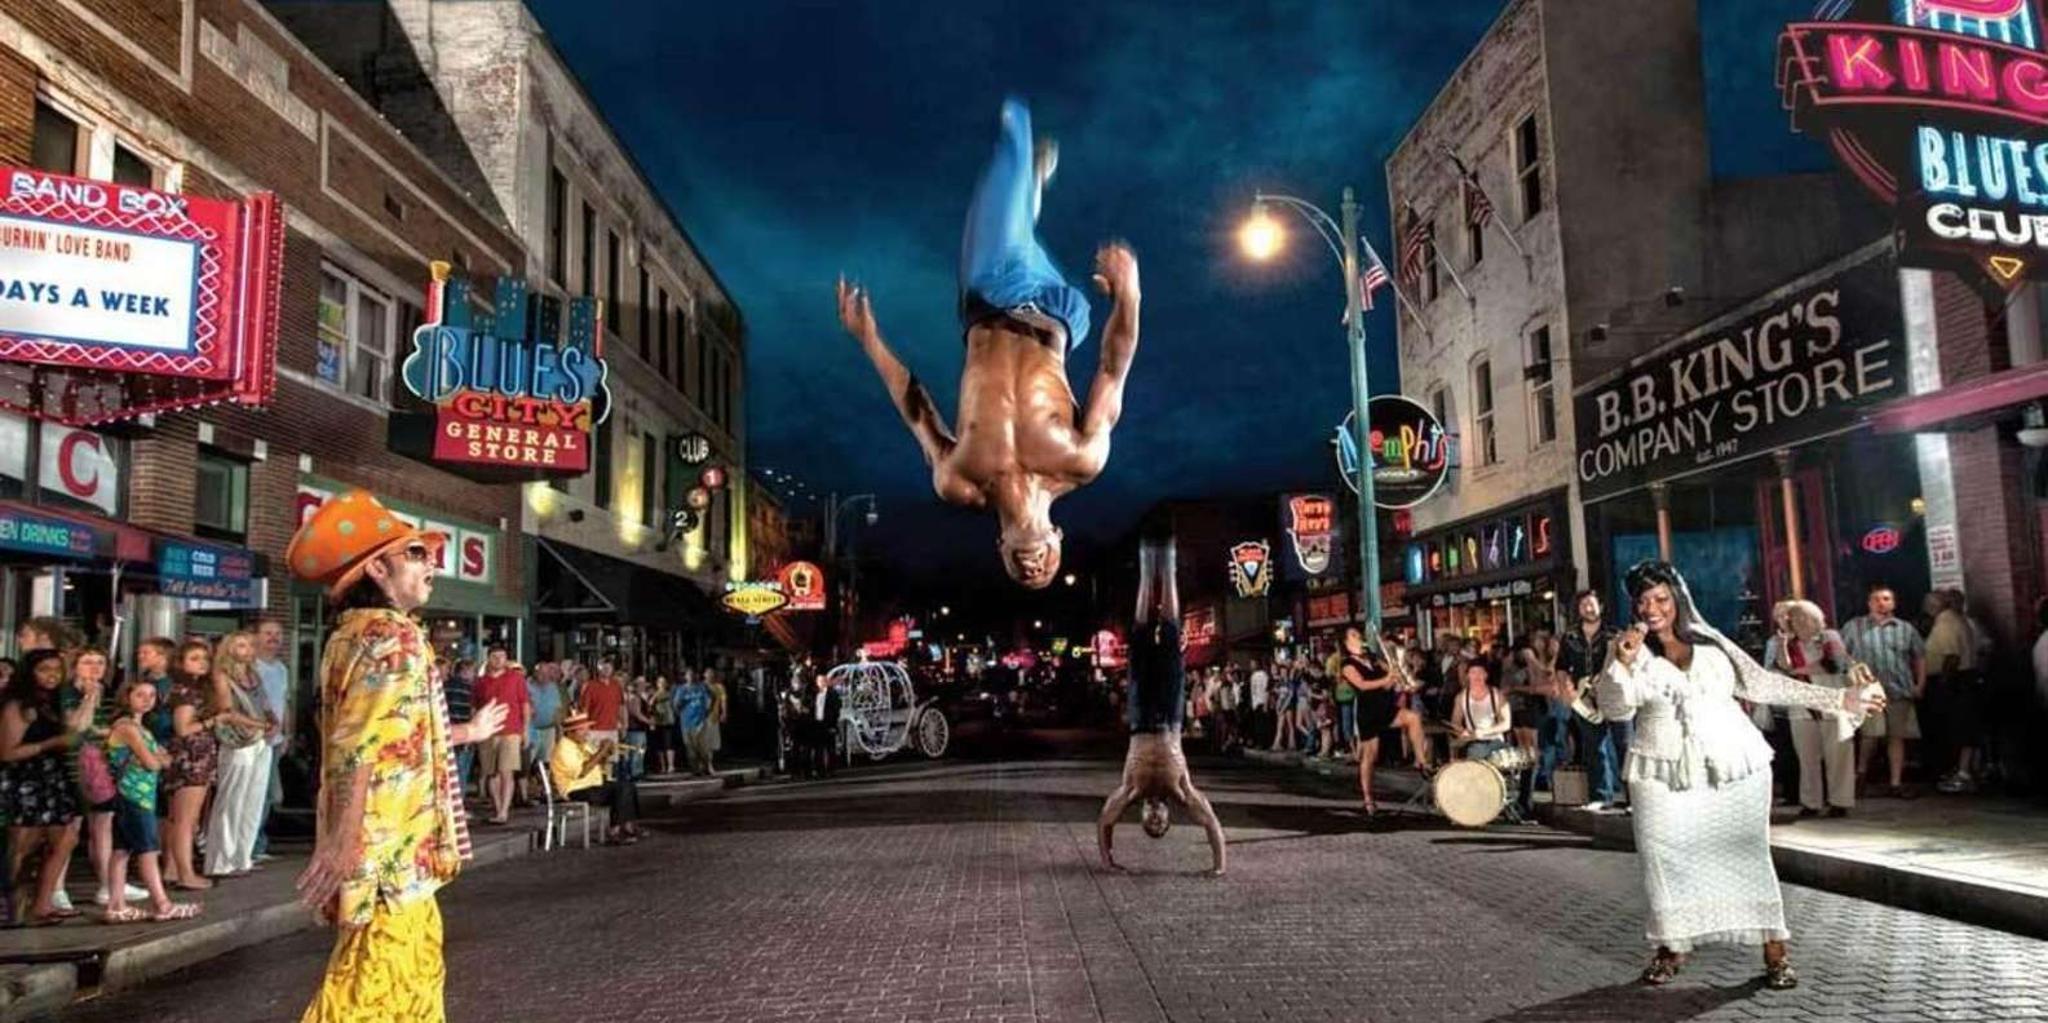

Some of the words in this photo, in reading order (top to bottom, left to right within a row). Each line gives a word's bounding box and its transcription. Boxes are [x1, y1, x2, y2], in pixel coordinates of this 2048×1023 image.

[1827, 33, 2048, 111] KING
[11, 172, 108, 207] BAND
[119, 187, 189, 217] BOX
[56, 234, 90, 257] LOVE
[96, 241, 132, 262] BAND
[71, 287, 89, 307] A
[101, 290, 170, 317] WEEK
[432, 326, 583, 404] BLUES
[453, 392, 585, 428] CITY
[1579, 402, 1720, 482] COMPANY
[1731, 339, 1894, 433] STORE
[446, 421, 577, 449] GENERAL
[680, 435, 709, 462] CLUB
[58, 431, 98, 496] C
[468, 441, 556, 463] STORE
[675, 510, 688, 527] 2
[21, 522, 69, 548] DRINKS
